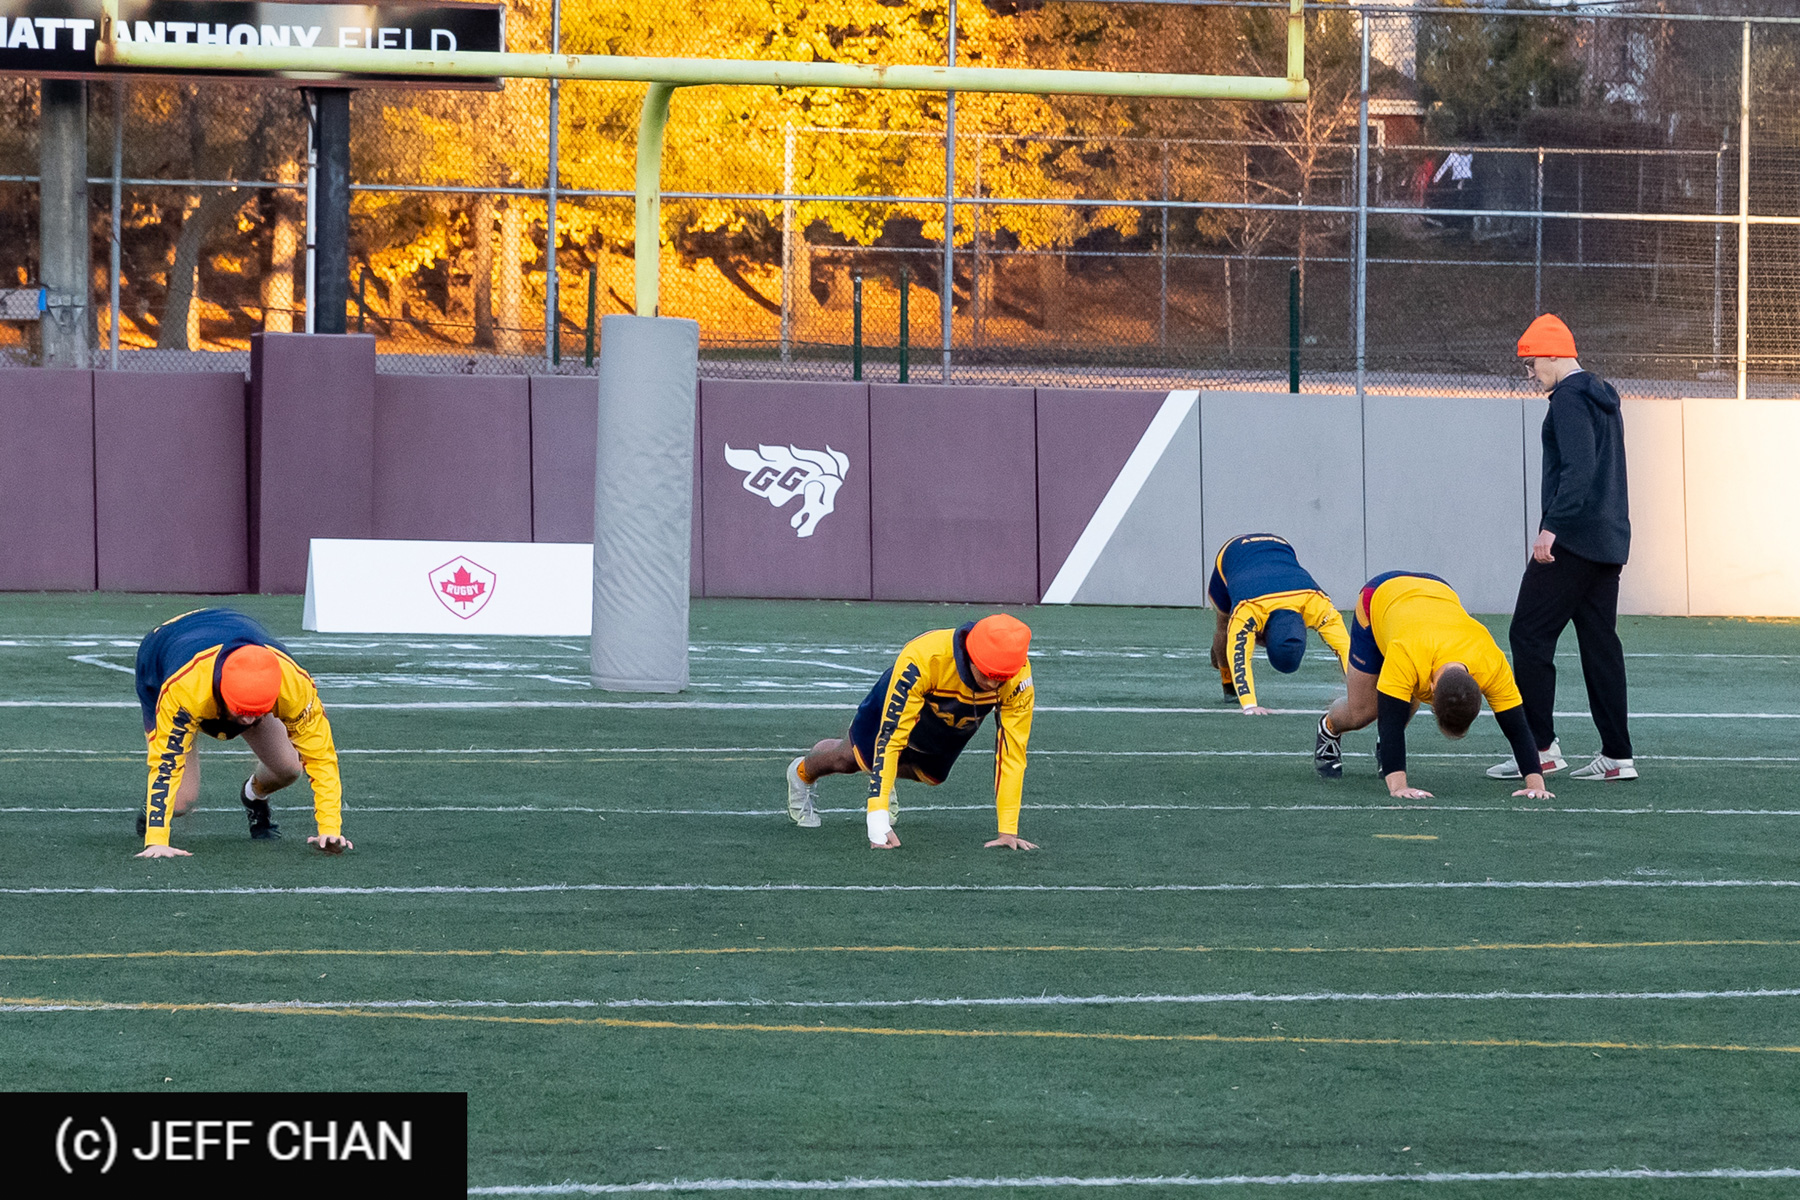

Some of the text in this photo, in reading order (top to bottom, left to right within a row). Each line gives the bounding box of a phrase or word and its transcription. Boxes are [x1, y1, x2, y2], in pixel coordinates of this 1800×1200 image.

[0, 17, 95, 50] ATT
[749, 466, 810, 492] GG
[445, 583, 479, 596] RUGBY
